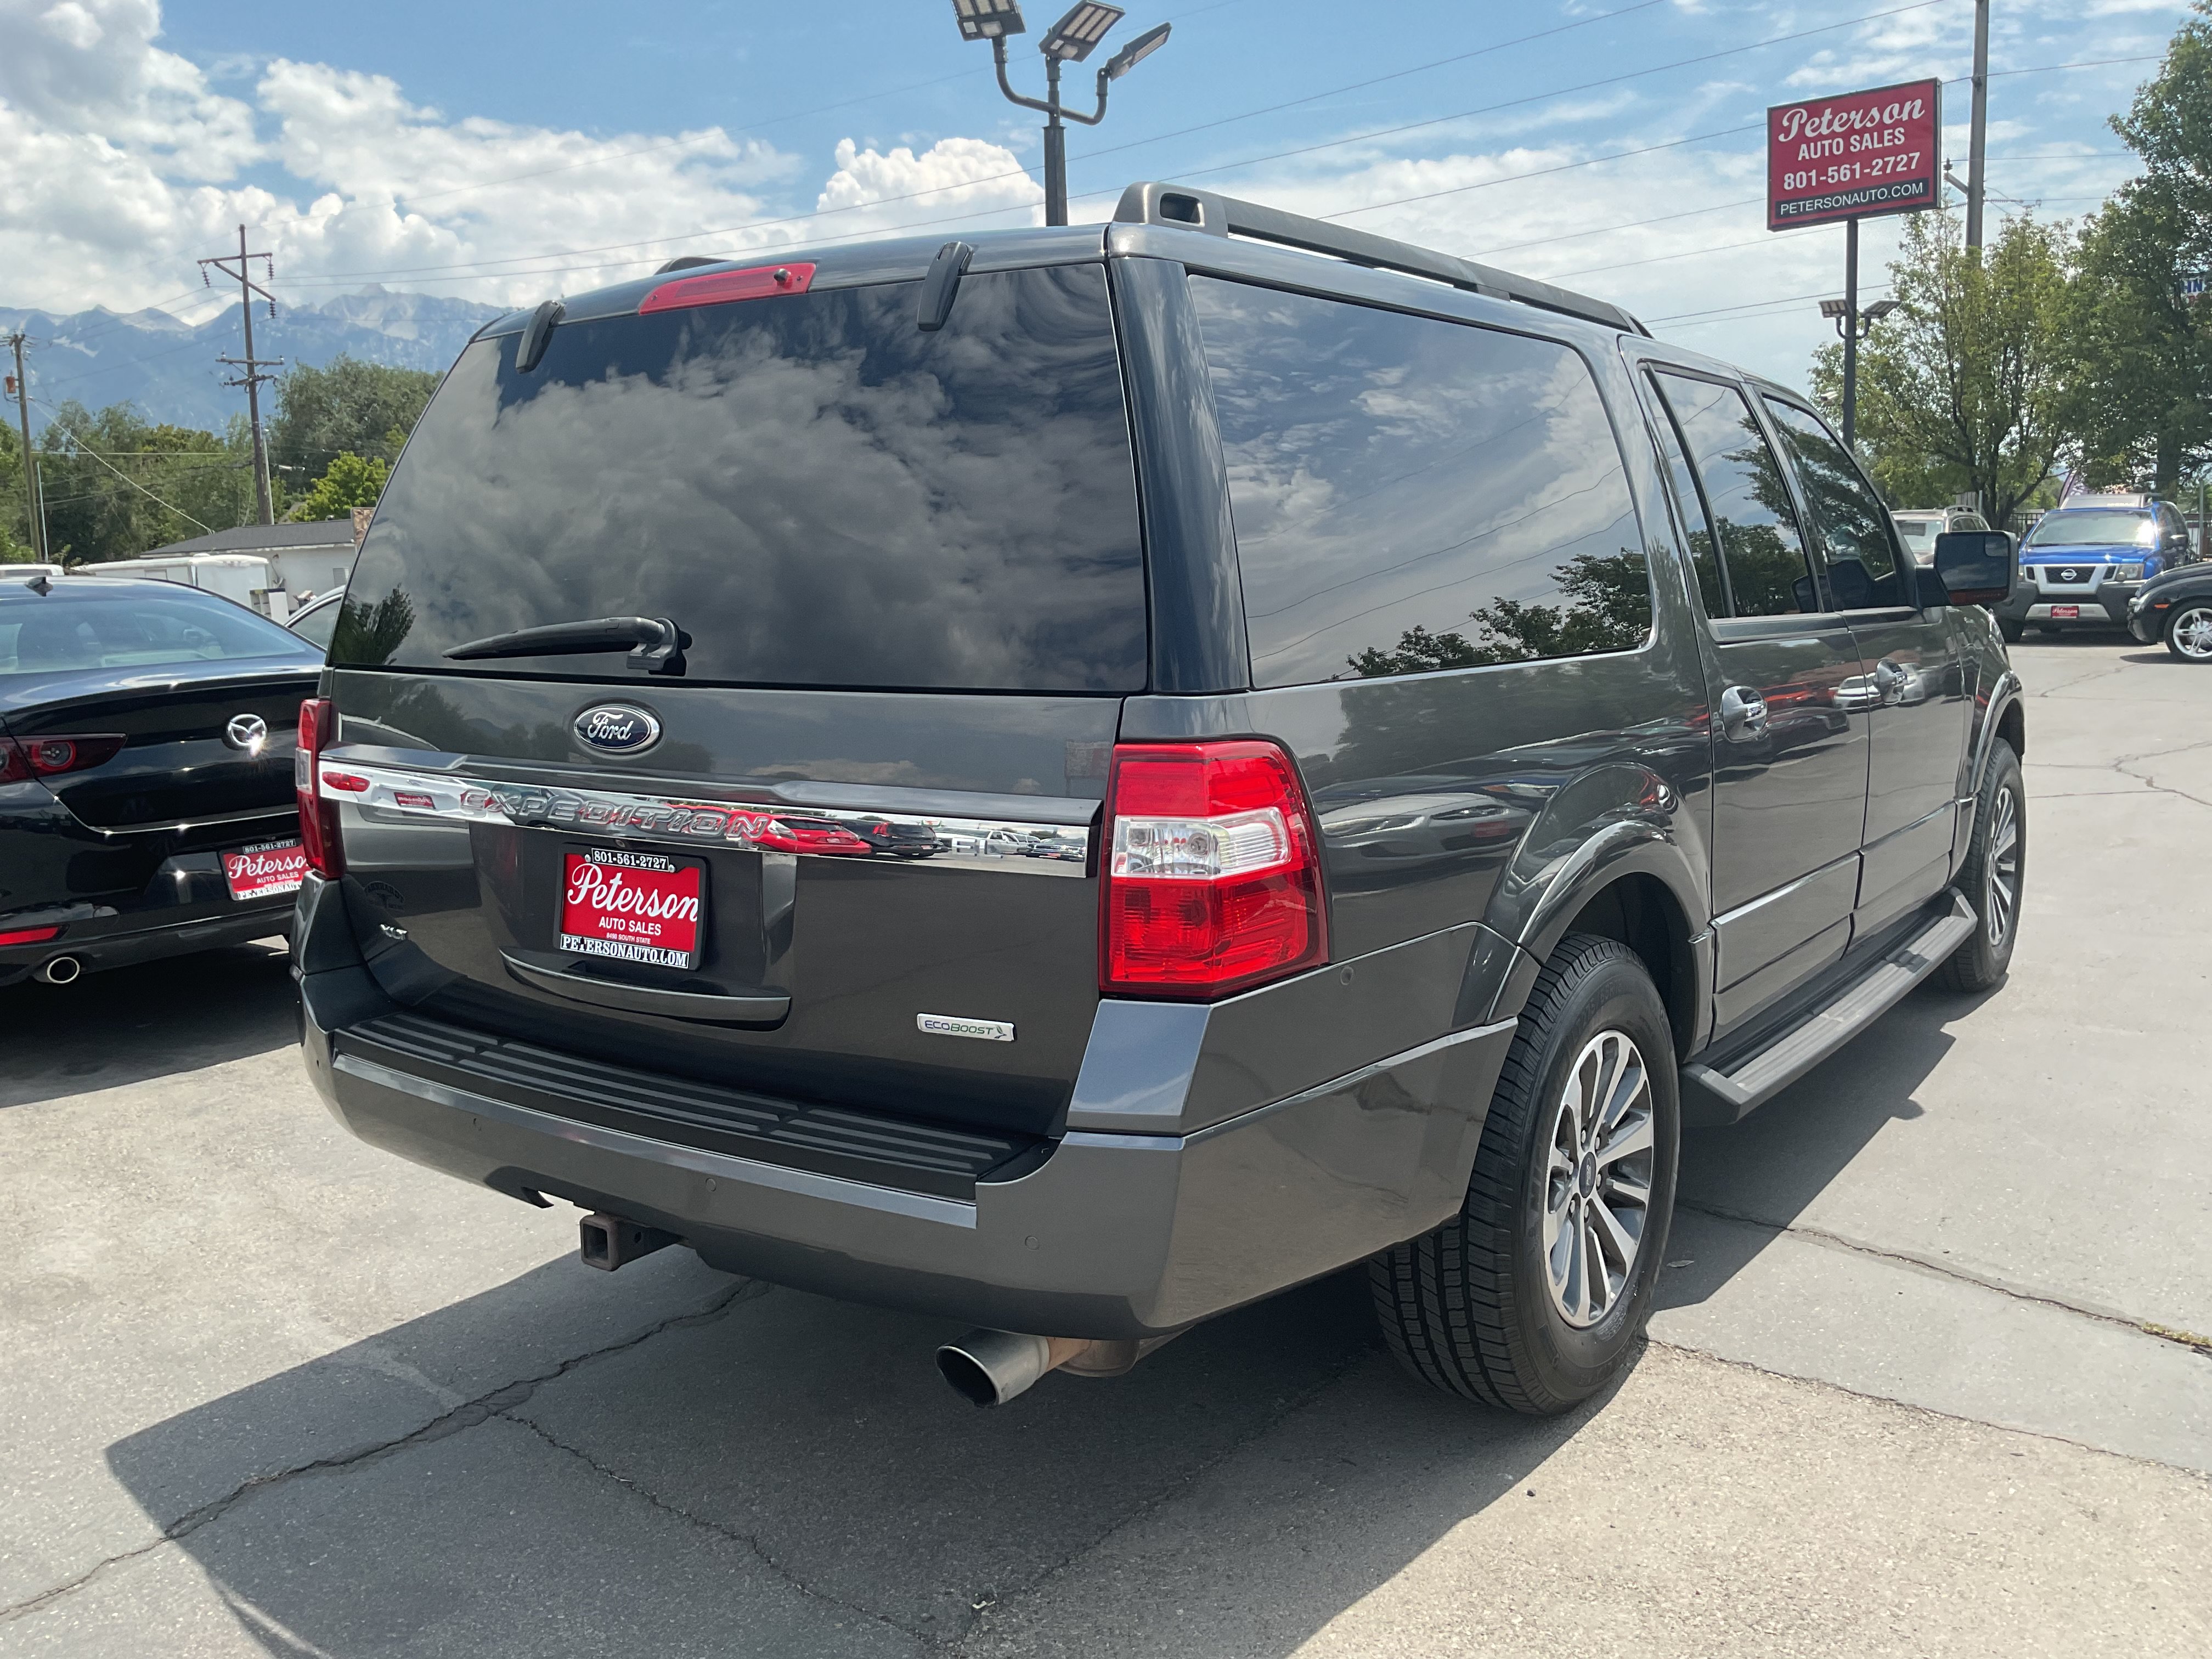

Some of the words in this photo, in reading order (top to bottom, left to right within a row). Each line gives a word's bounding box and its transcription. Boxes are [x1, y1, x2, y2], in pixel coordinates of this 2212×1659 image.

[1778, 99, 1925, 142] Peterson
[1798, 138, 1844, 161] AUTO
[1849, 127, 1905, 153] SALES
[1784, 152, 1920, 190] 801-561-2727
[1780, 182, 1923, 215] PETERSONAUTO.COM
[587, 712, 634, 740] Ford
[461, 790, 769, 838] EXPEDITION
[245, 840, 295, 853] 801-561-2727
[952, 837, 1003, 859] EL
[594, 850, 667, 870] 801-561-2727
[257, 876, 275, 884] AUTO
[276, 872, 299, 881] SALES
[567, 863, 699, 922] Peterson
[599, 916, 626, 931] AUTO
[628, 920, 662, 936] SALES
[618, 934, 635, 942] SOUTH
[925, 1020, 994, 1035] ECOBOOST
